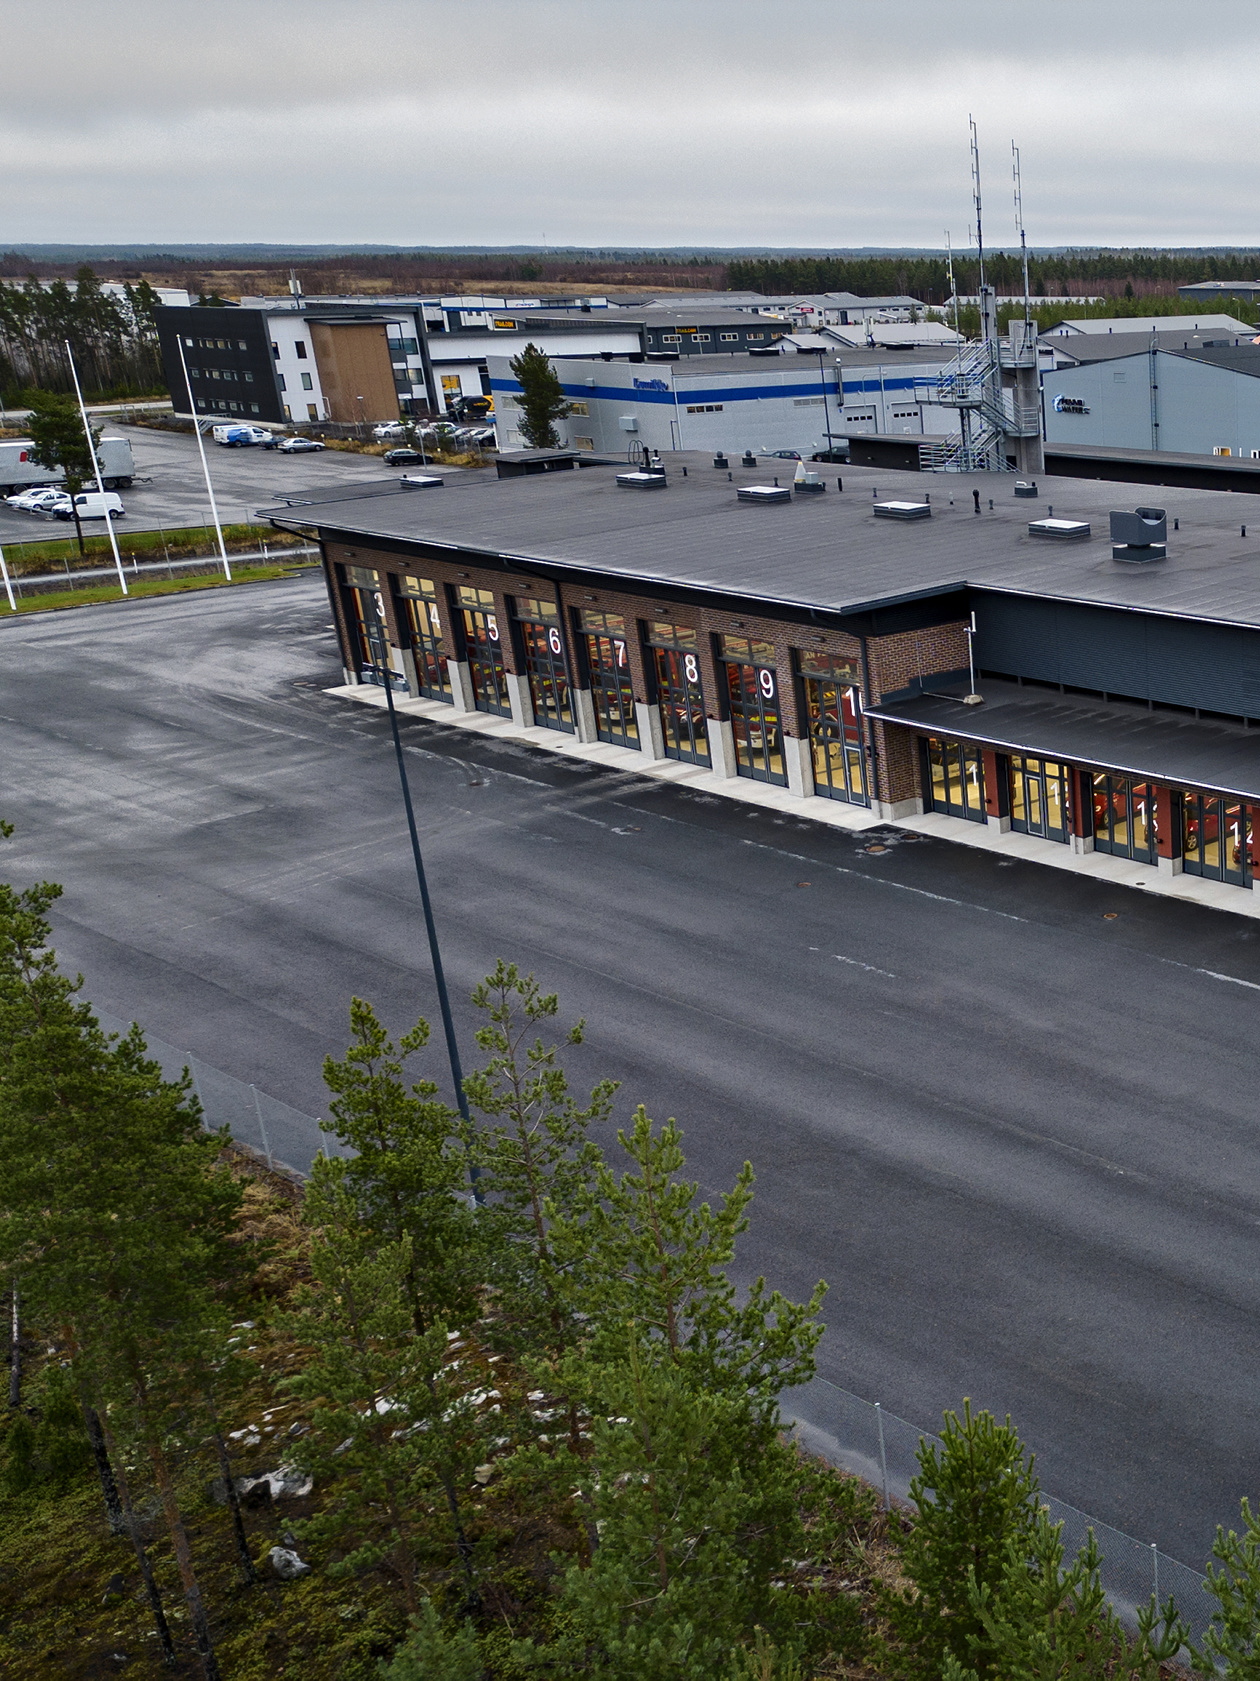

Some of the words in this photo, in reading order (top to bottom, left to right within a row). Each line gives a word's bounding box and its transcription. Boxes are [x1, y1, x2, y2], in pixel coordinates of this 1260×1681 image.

[373, 591, 386, 618] 3
[429, 603, 441, 630] 4
[487, 614, 500, 642] 5
[548, 627, 562, 655] 6
[613, 640, 626, 668] 7
[684, 653, 699, 683] 8
[759, 669, 774, 699] 9
[845, 686, 865, 717] 1
